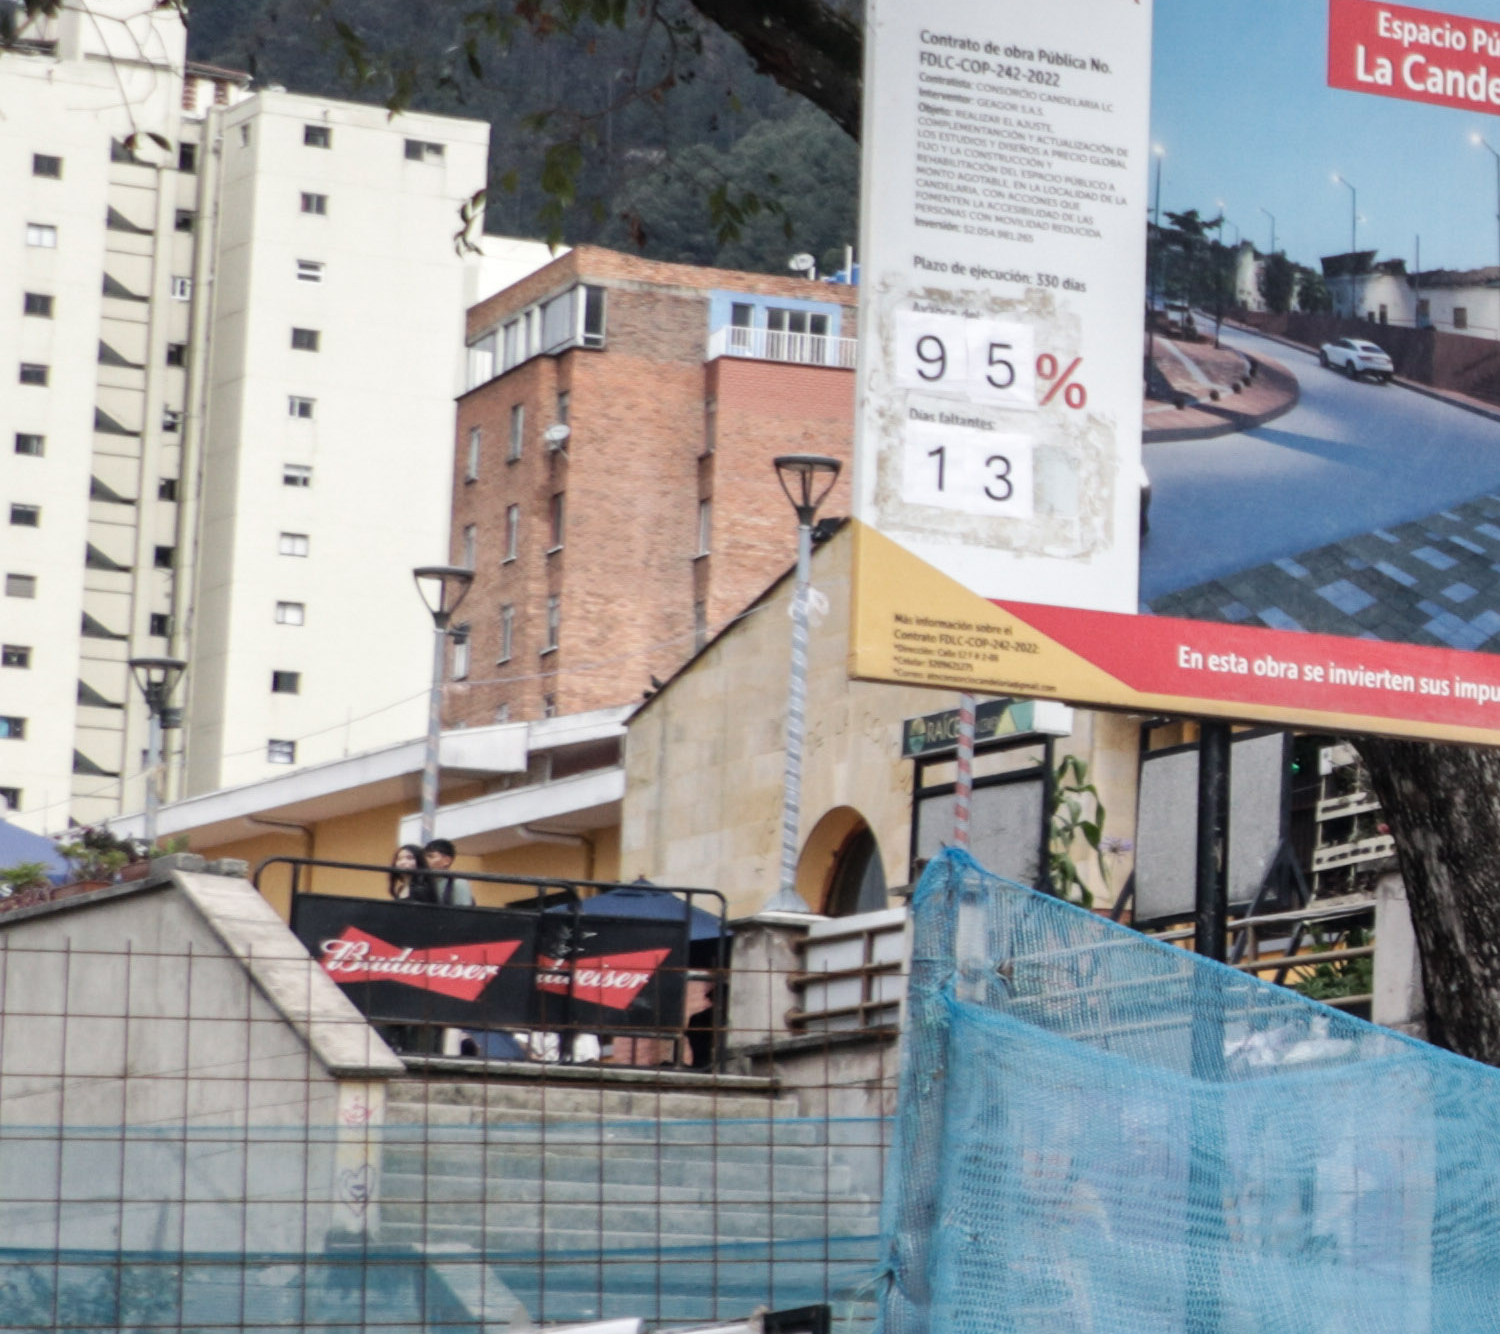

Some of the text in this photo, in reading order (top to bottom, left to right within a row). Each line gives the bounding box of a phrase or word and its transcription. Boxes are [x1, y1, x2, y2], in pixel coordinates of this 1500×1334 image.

[1378, 10, 1466, 51] Espacio
[920, 30, 1112, 74] Contrato de obra Pública No.
[920, 51, 1060, 87] FDLC-COP-242-2022
[1356, 45, 1393, 86] La
[914, 255, 947, 273] Plazo
[951, 262, 966, 276] de
[970, 266, 1032, 285] ejecución:
[1037, 272, 1059, 287] 330
[1178, 646, 1203, 669] En
[1209, 651, 1248, 674] esta
[1253, 655, 1298, 679] obra
[1303, 665, 1325, 682] se
[1330, 662, 1415, 692] invierten
[1420, 677, 1449, 696] sus
[320, 939, 499, 981] Budweiser
[536, 958, 649, 989] udweiser
